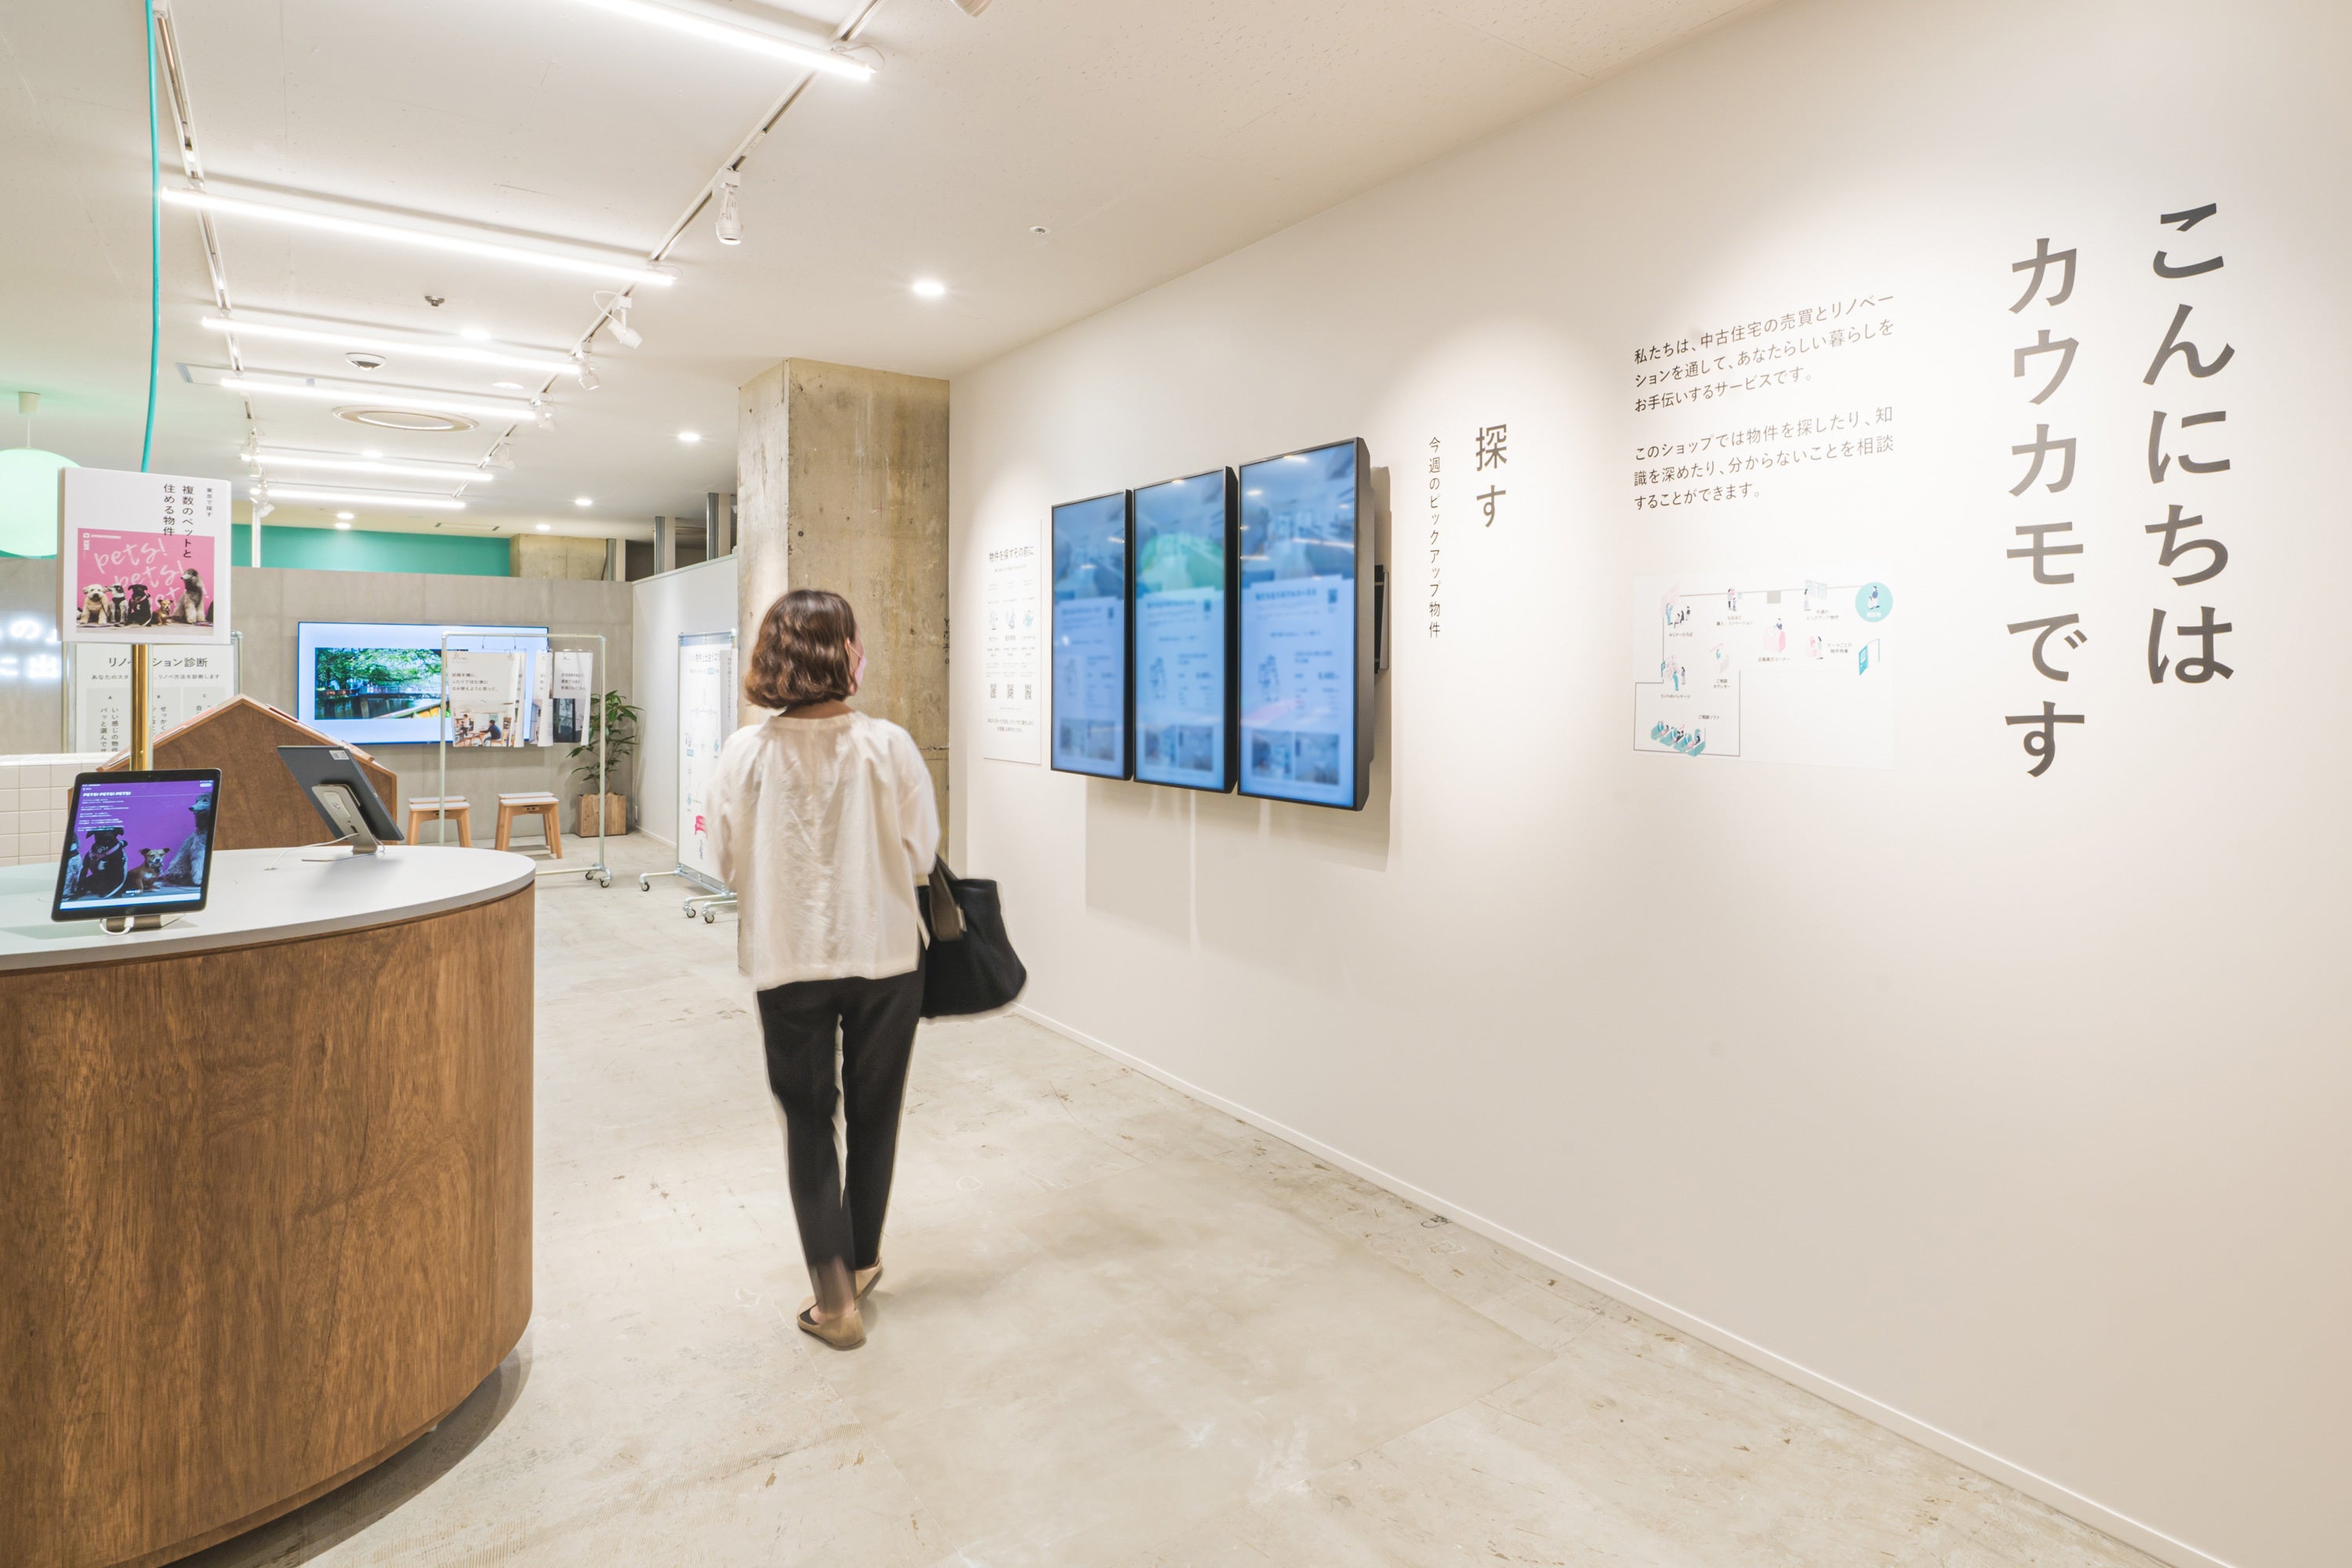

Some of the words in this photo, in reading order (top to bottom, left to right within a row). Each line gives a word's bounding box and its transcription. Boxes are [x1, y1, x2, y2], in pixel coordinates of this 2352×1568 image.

[1635, 296, 1893, 363] 私たちは、中古住宅の売買とリノベー
[1635, 319, 1893, 387] ションを通して、あなたらしい暮らしを
[1635, 366, 1811, 412] お手伝いするサービスです。
[1634, 435, 1893, 486] 識を深めたり、分からないことを相談
[1636, 406, 1893, 460] このショップでは物件を探したり、知
[2143, 203, 2235, 684] こんにちは
[1475, 423, 1508, 528] 探す
[1635, 482, 1760, 510] することができます。
[163, 483, 176, 536] 住める物件
[182, 485, 194, 558] 複数のペットと
[1429, 437, 1441, 638] 今週のピックアップ物件
[2005, 238, 2087, 777] カウカモです
[93, 538, 168, 574] pets!
[108, 657, 208, 668] リノション診断
